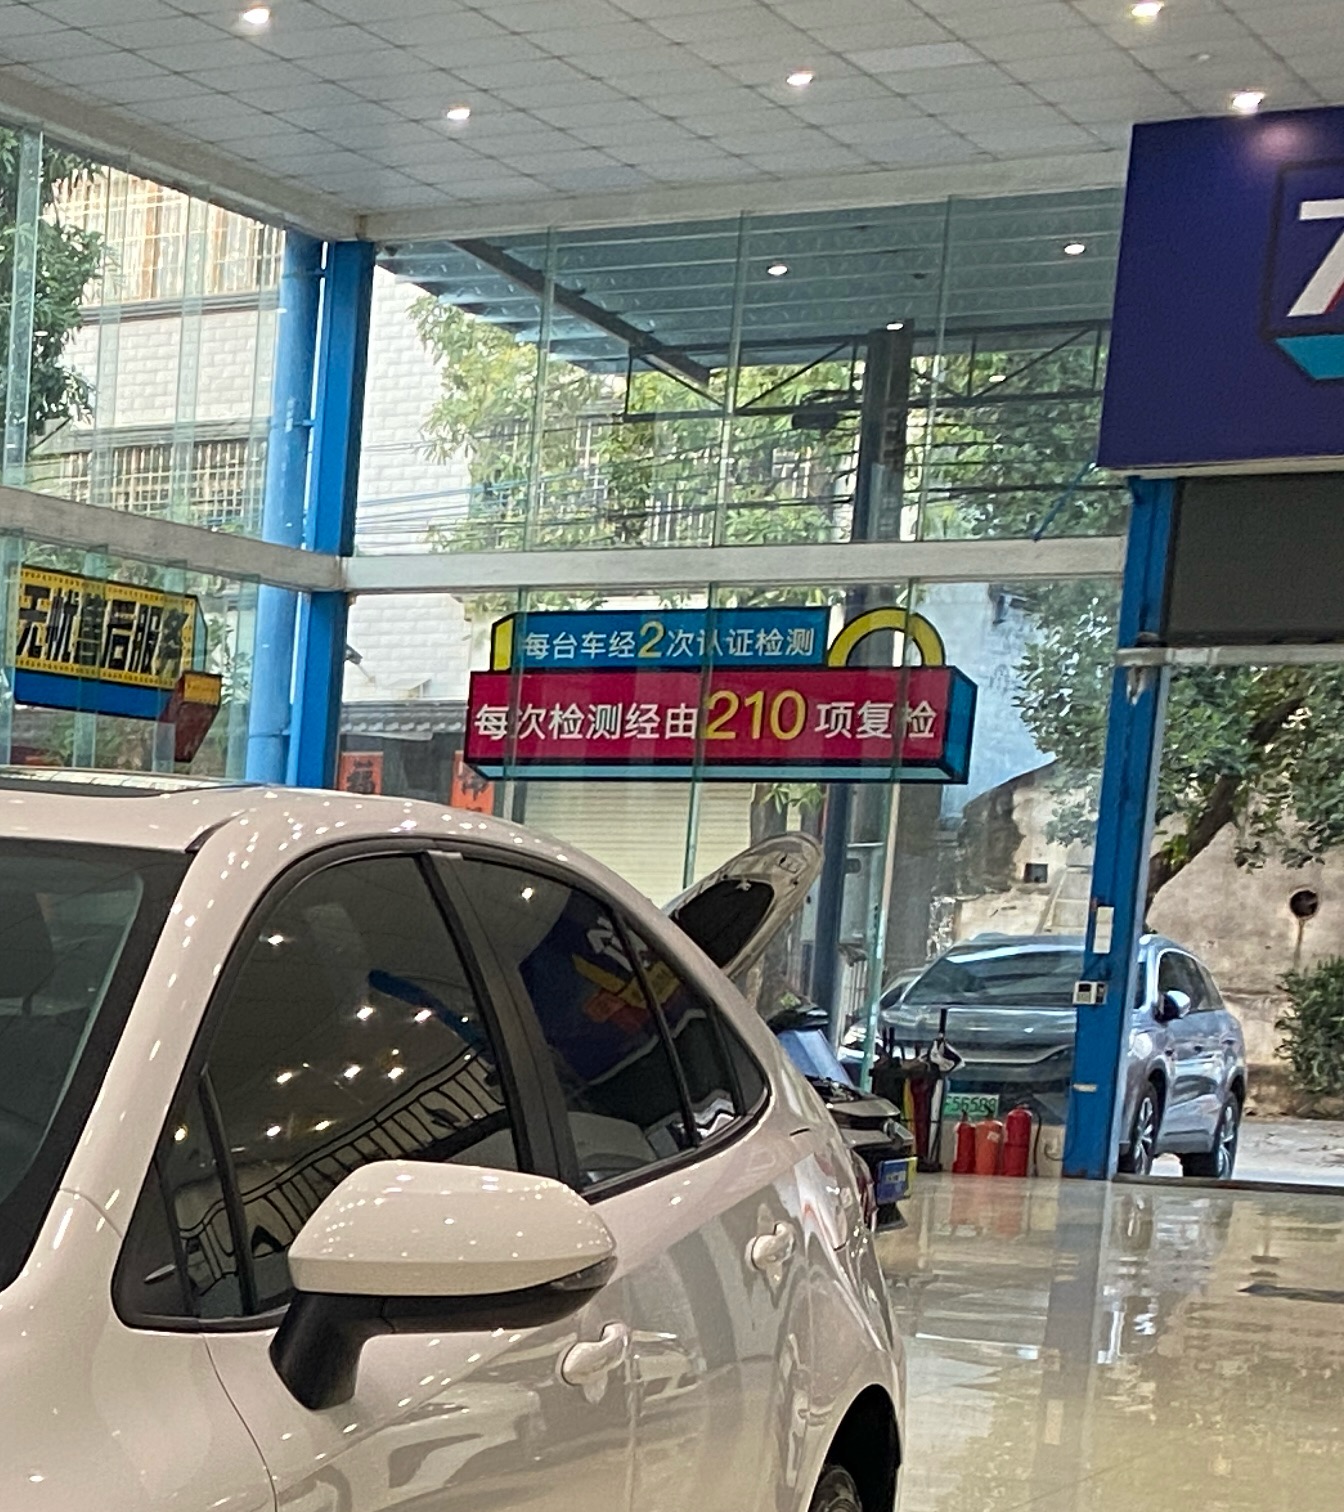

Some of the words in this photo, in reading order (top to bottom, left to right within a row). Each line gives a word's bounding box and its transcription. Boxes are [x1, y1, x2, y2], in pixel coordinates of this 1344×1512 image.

[524, 621, 814, 660] 每台车经2次认证检测
